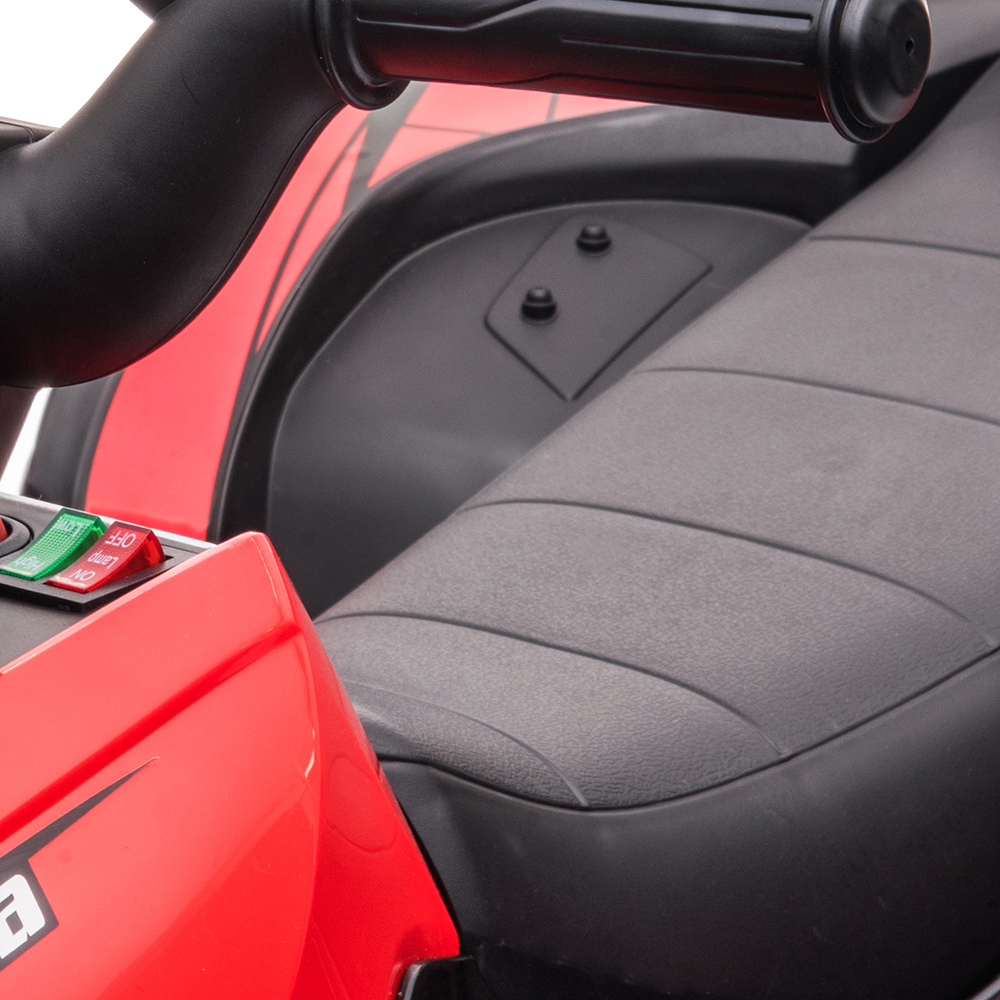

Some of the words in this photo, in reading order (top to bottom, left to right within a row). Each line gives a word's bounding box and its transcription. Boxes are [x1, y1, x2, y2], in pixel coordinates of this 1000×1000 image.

[105, 530, 137, 549] OFF
[14, 556, 46, 572] High
[87, 550, 119, 570] Lamp
[69, 568, 96, 582] ON
